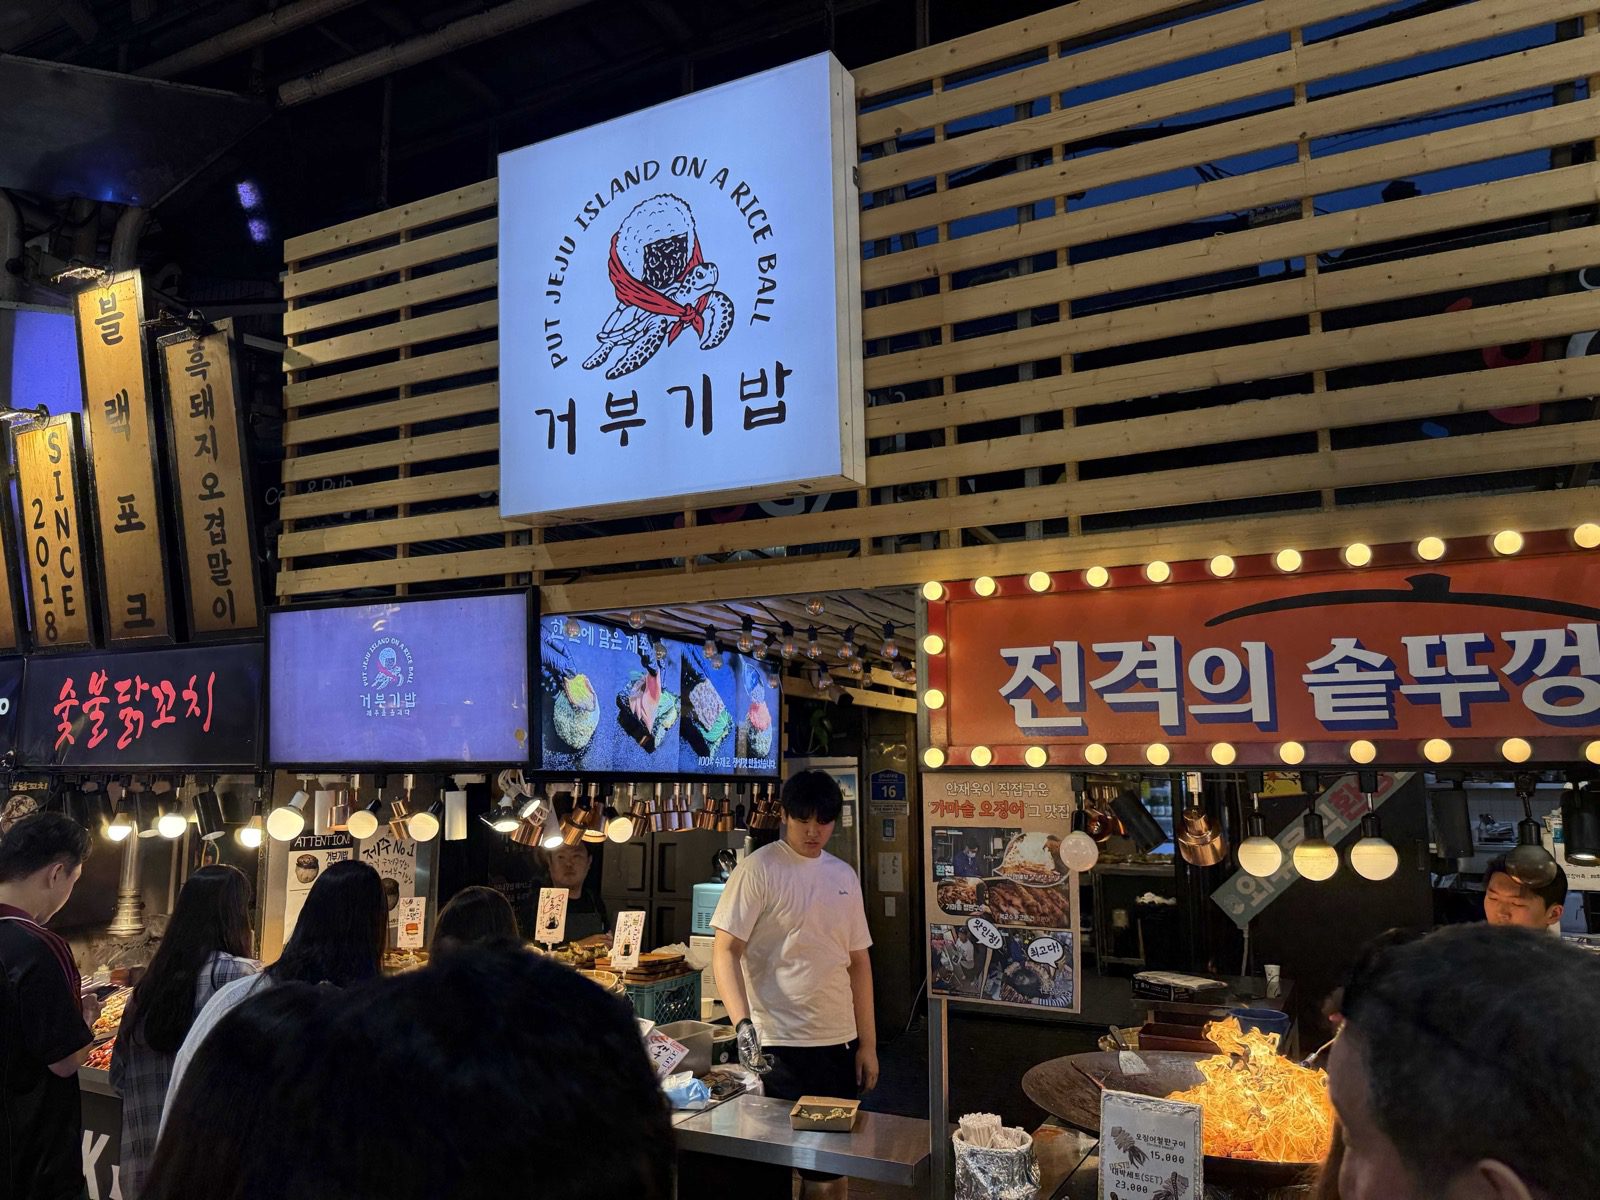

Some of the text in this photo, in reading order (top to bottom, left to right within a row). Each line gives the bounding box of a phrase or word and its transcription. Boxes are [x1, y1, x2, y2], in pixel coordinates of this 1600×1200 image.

[543, 155, 777, 370] PUT JEJU ISLAND ON A RICE BALL
[534, 360, 793, 456] 거부기밥
[94, 292, 155, 629] 블랙포크
[47, 431, 76, 617] SINCE
[31, 497, 58, 642] 2018
[363, 652, 371, 670] JEJU
[370, 637, 390, 653] ISLAND
[391, 638, 400, 646] ON
[404, 648, 413, 664] RICE
[599, 628, 622, 651] 담은
[625, 634, 649, 656] 제주
[998, 623, 1600, 730] 진격의 솥뚜껑
[53, 668, 216, 751] 숯불닭꼬치
[360, 692, 417, 709] 거부기밥
[881, 784, 897, 799] 16
[946, 782, 1049, 797] 안재욱이 직접구운
[1045, 804, 1070, 819] 맛집
[362, 837, 391, 859] 제주
[973, 918, 1000, 947] 맛인정!
[1031, 943, 1060, 957] 최고다!
[1136, 1133, 1186, 1149] 오징어철판구이
